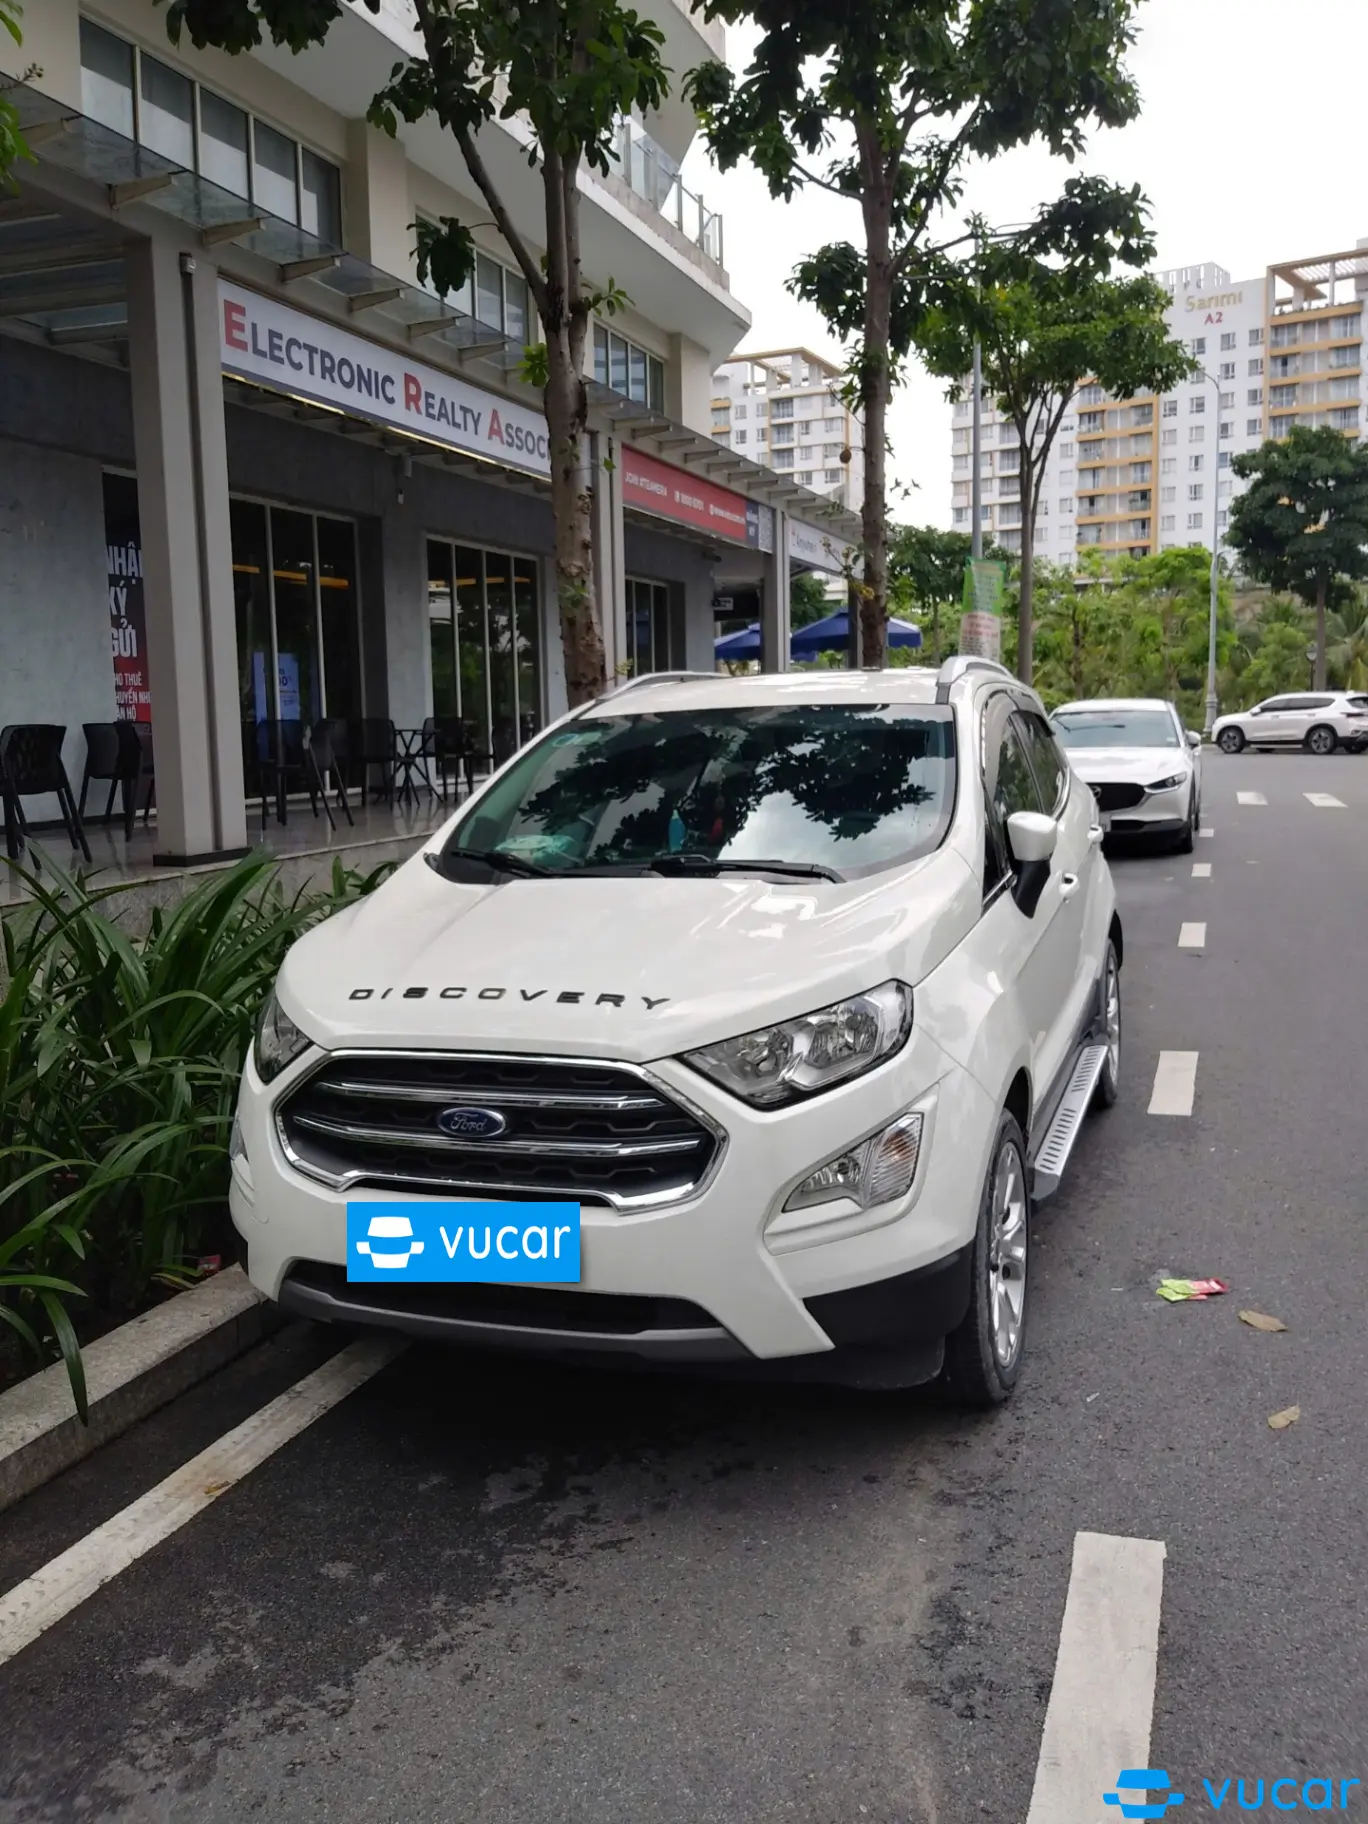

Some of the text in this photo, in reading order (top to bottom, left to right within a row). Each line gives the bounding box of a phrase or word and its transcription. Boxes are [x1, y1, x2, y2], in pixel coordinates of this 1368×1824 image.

[1185, 291, 1242, 312] Sarimi
[1204, 311, 1224, 326] A2
[223, 299, 396, 405] ELECTRONIC
[404, 372, 482, 436] REALTY
[124, 671, 142, 686] THUÊ
[349, 987, 671, 1010] DISCOVERY
[451, 1112, 488, 1131] Ford
